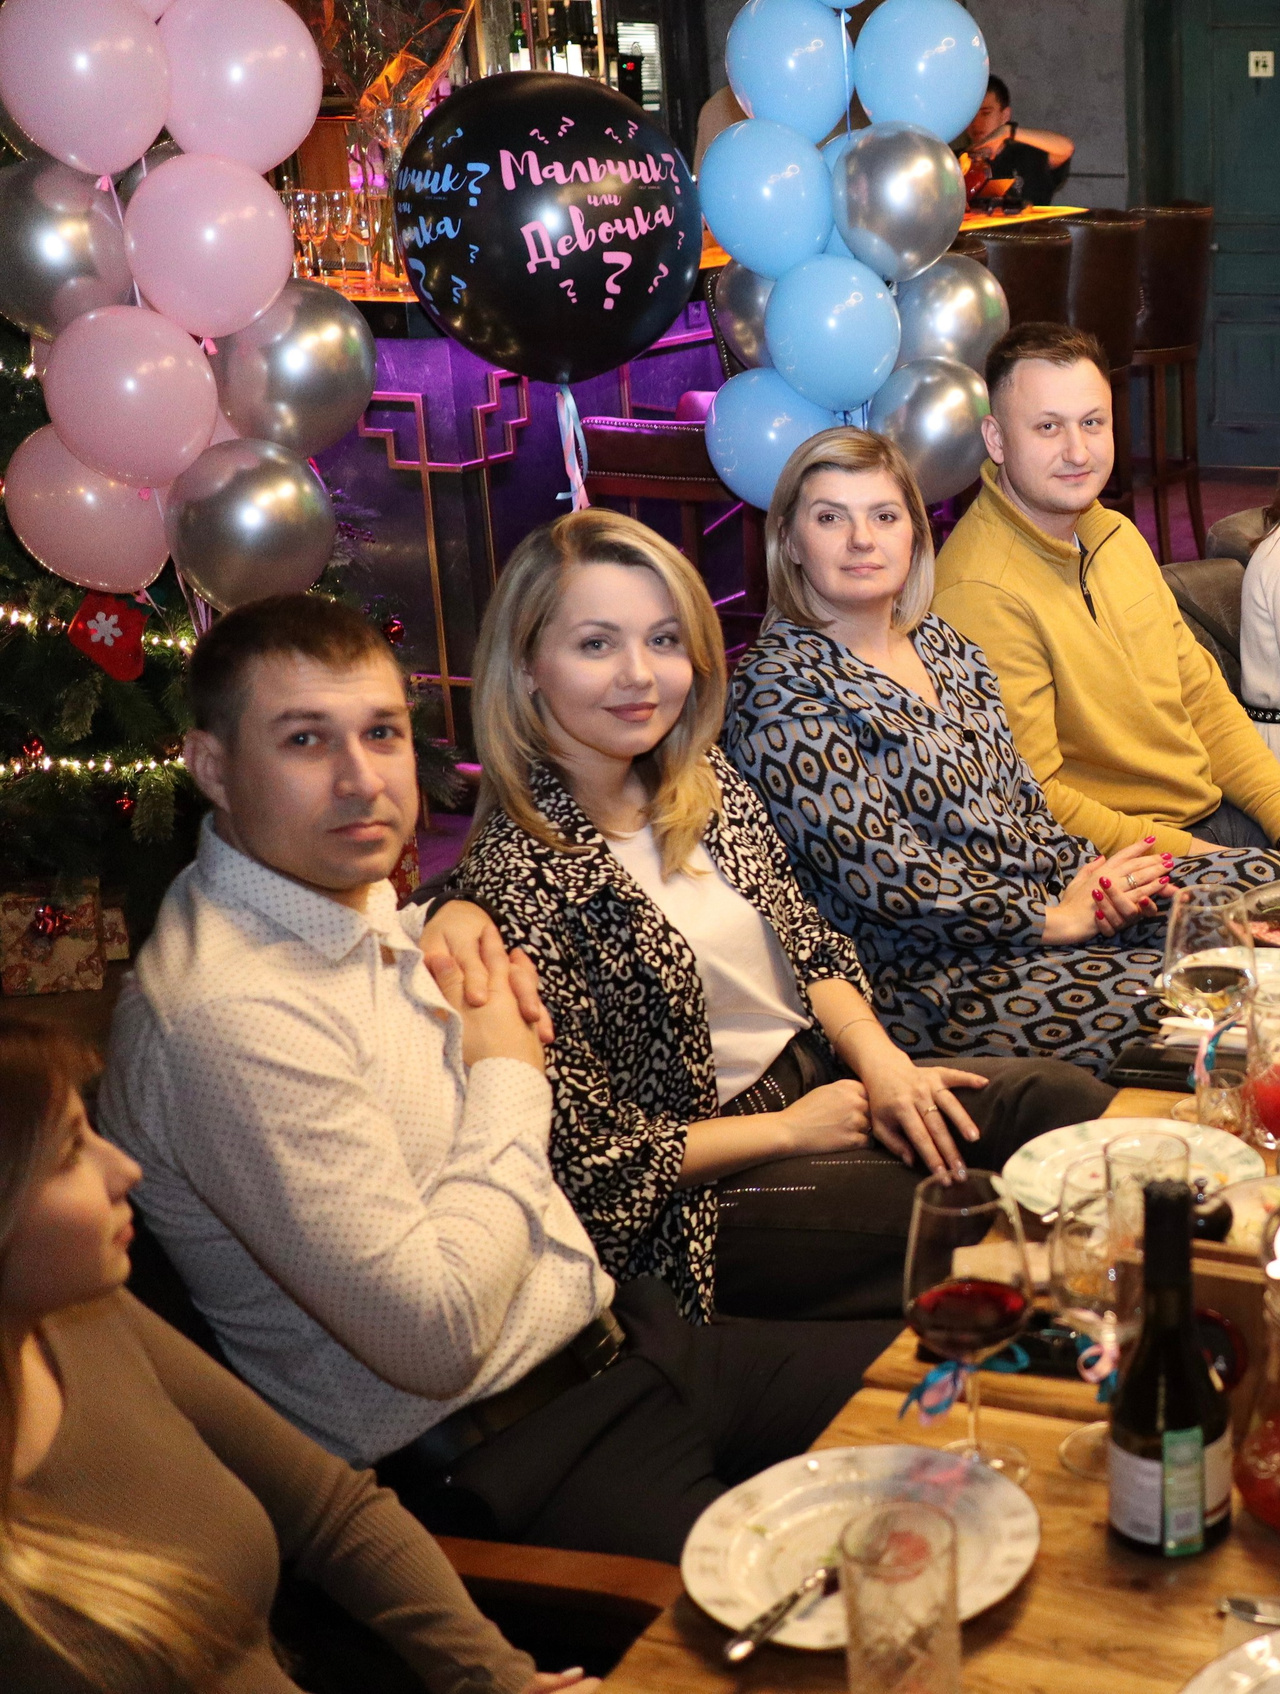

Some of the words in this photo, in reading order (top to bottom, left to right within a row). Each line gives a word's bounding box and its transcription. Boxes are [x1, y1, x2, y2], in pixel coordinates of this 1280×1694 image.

[499, 149, 682, 195] Мальчик?
[586, 194, 622, 207] или
[520, 205, 675, 274] Девочка
